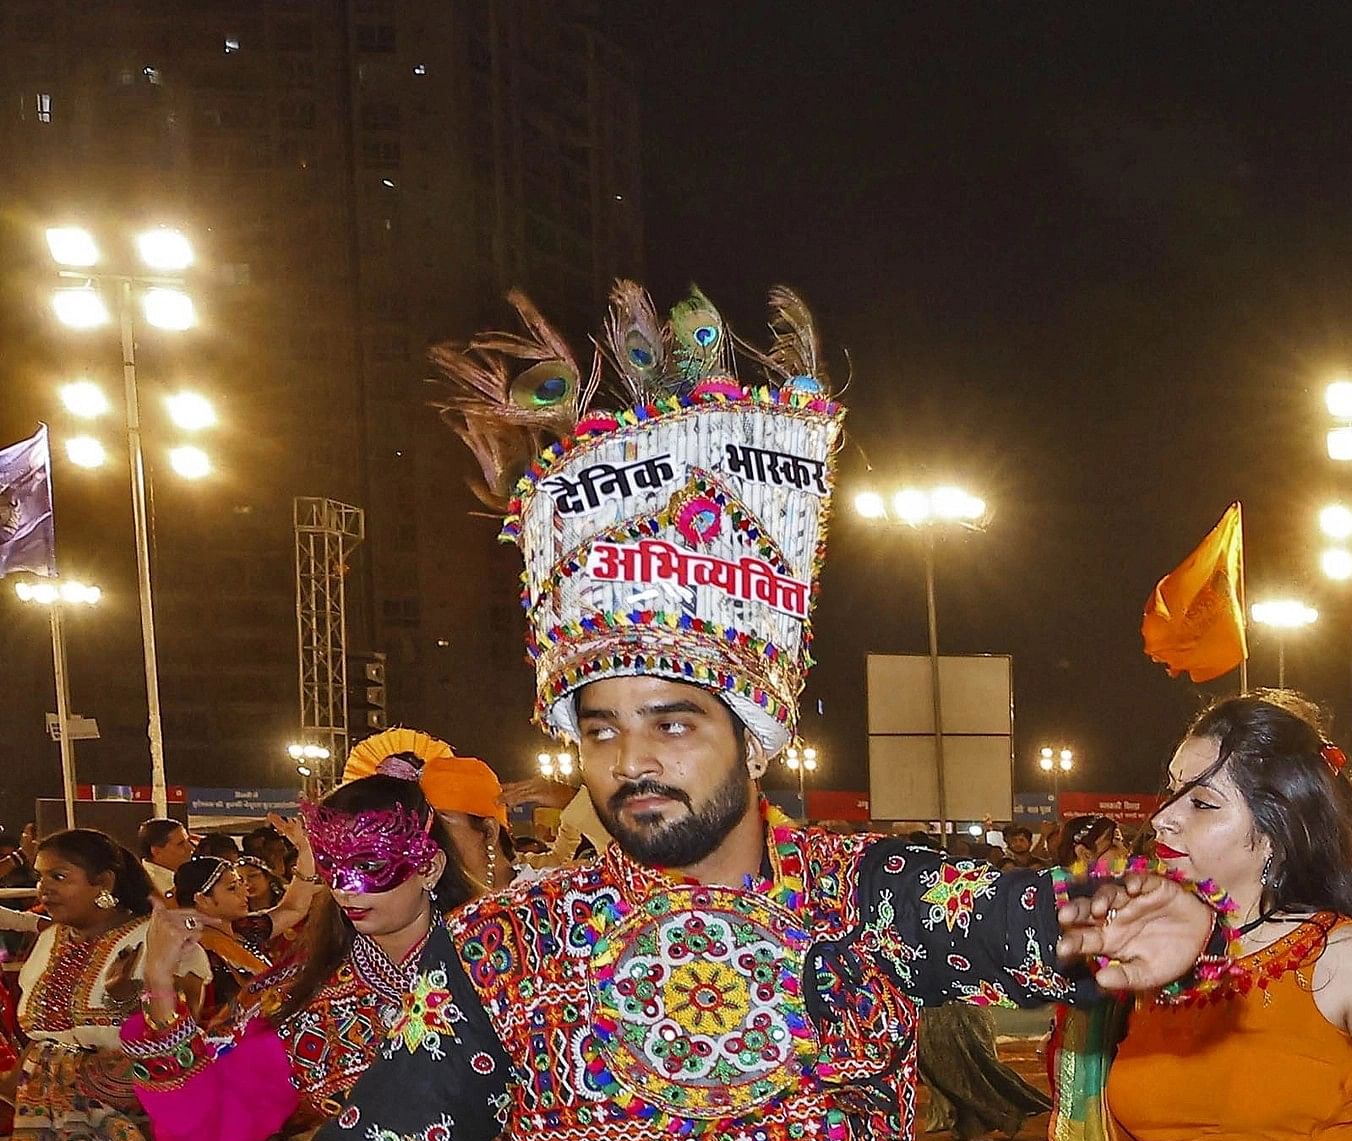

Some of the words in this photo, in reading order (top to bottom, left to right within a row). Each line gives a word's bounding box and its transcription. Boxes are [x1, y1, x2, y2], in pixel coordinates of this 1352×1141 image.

[542, 453, 675, 514] दैनिक
[726, 444, 828, 494] भास्कर
[593, 540, 809, 616] अभिव्यक्ति
